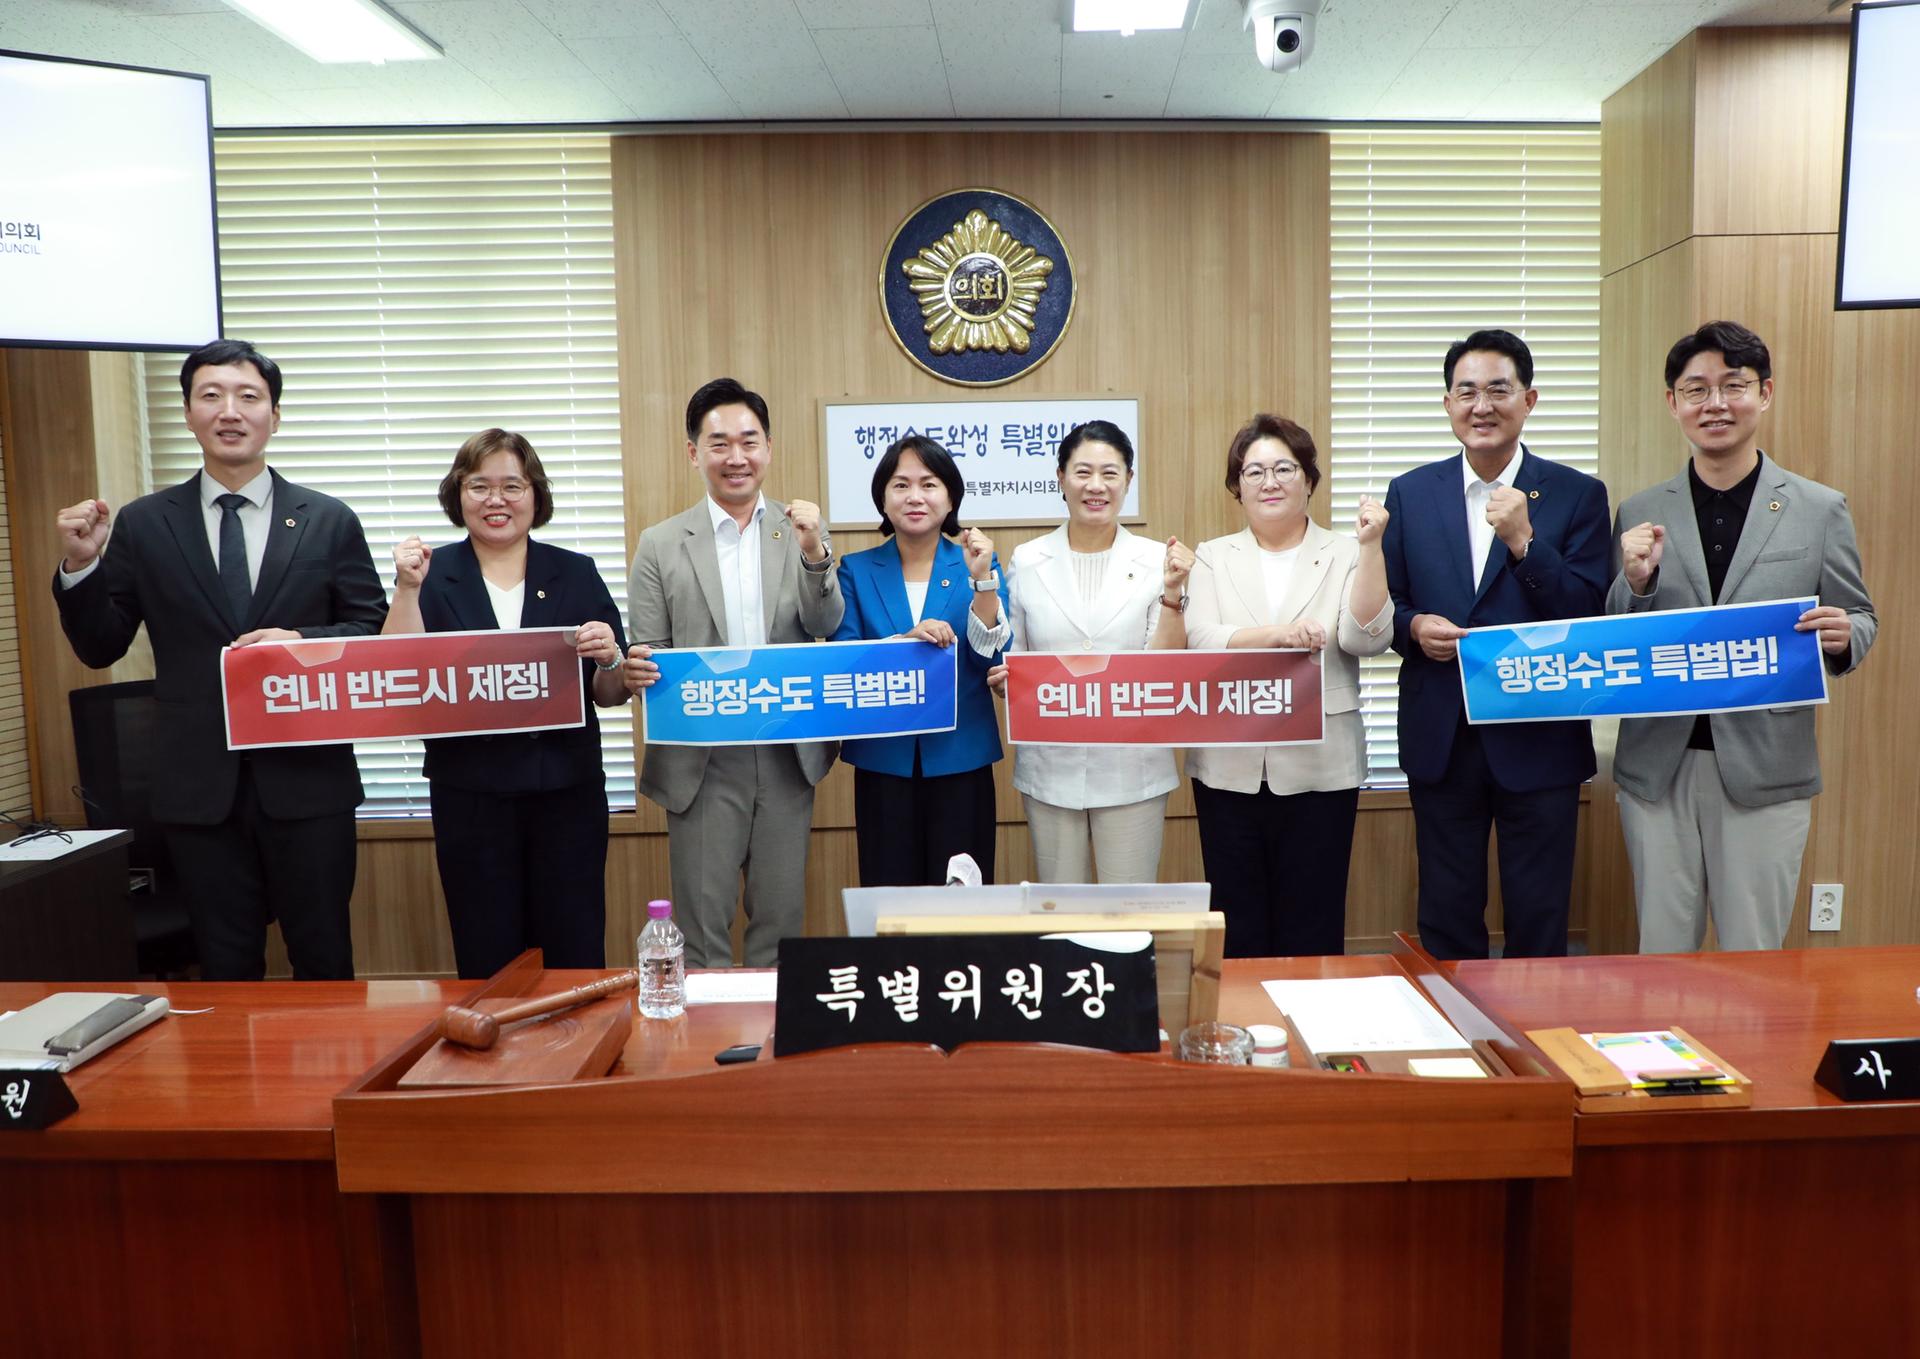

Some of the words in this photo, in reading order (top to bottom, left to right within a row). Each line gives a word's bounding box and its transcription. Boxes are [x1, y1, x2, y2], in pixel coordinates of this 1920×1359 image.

[0, 222, 40, 240] 의회
[953, 273, 1003, 300] 의회
[1001, 422, 1077, 456] 특별위
[965, 480, 1060, 496] 특별자치시의회
[1496, 648, 1641, 693] 행정수도
[1650, 636, 1778, 681] 특별법!
[262, 672, 338, 713] 연내
[347, 666, 458, 709] 반드시
[467, 661, 549, 701] 제정!
[681, 676, 814, 716] 행정수도
[823, 670, 925, 709] 특별법!
[1037, 682, 1101, 717] 연내
[1110, 681, 1207, 717] 반드시
[1217, 679, 1292, 715] 제정!
[816, 962, 1115, 1023] 특별위원장
[1853, 1050, 1892, 1090] 사
[1, 1079, 30, 1119] 원
